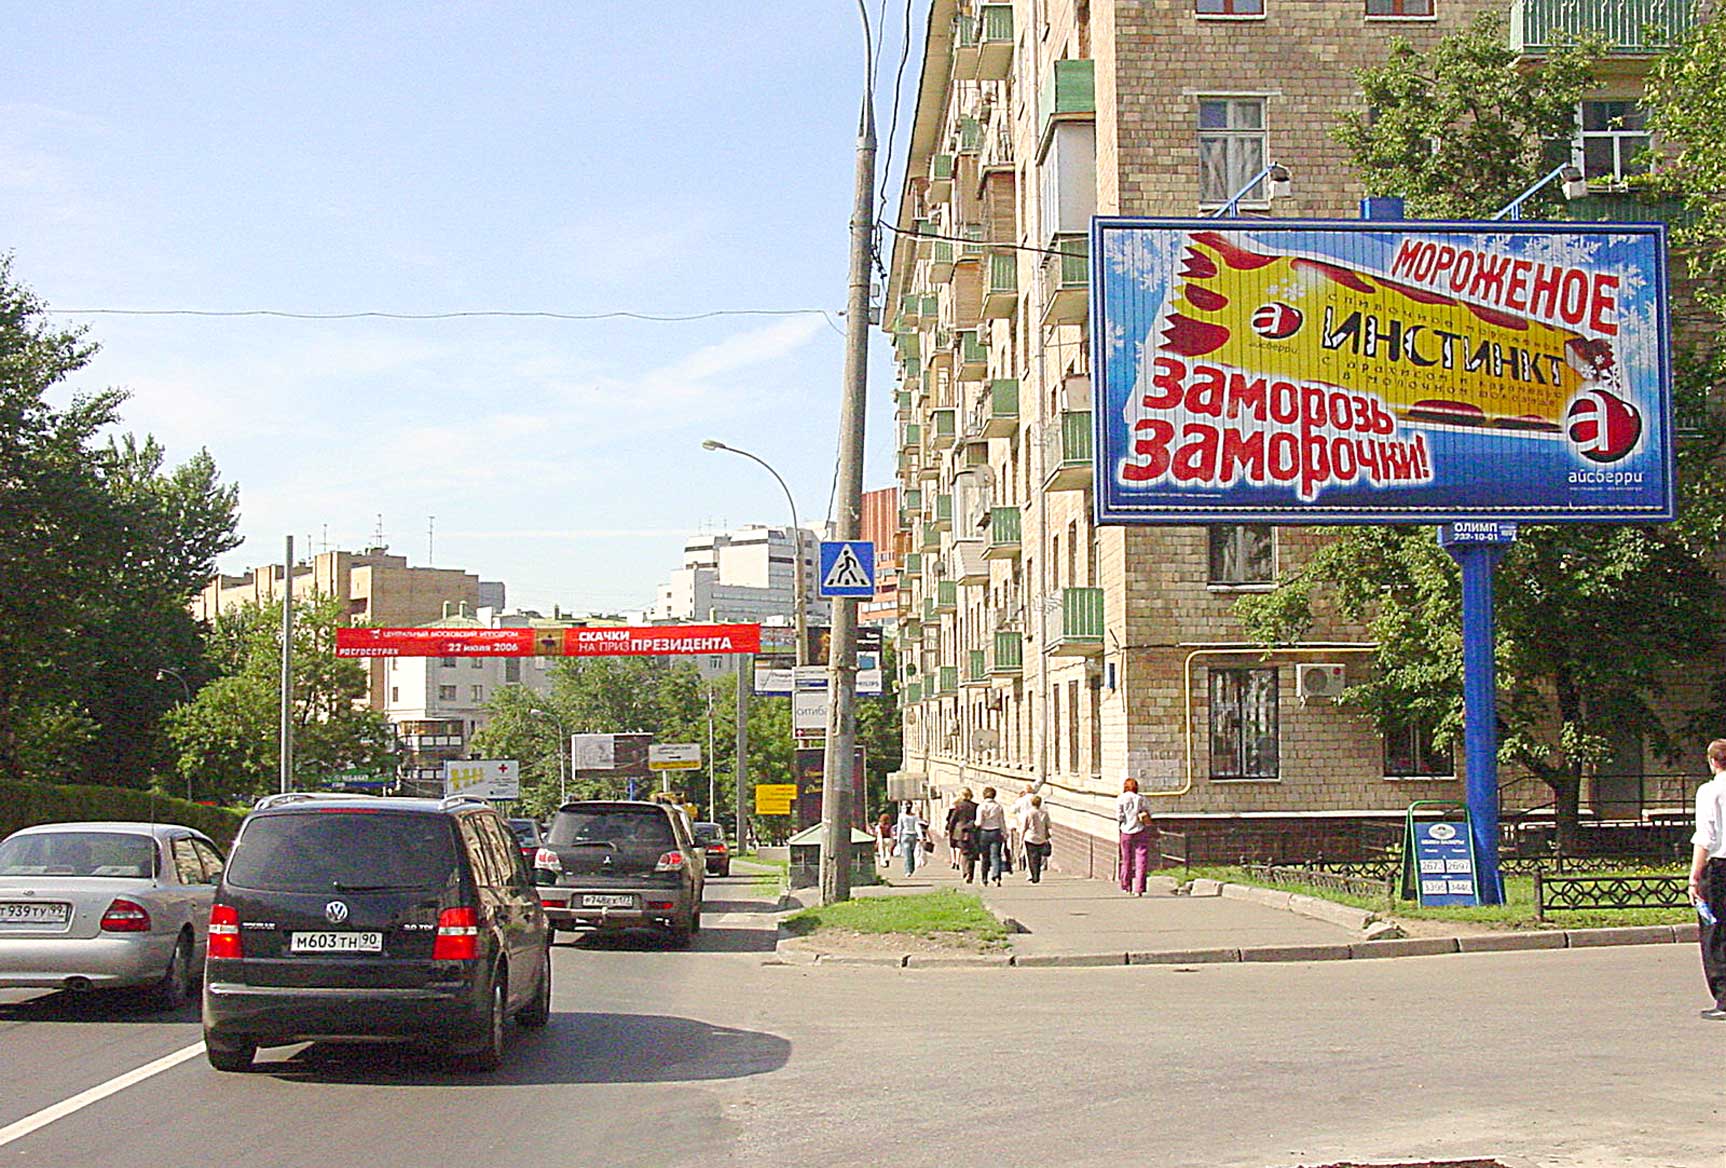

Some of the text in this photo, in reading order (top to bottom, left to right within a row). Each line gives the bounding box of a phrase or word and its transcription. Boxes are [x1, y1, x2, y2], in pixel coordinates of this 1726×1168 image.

[1391, 237, 1621, 337] МОРОЖЕНОЕ
[1321, 305, 1565, 388] ИНСТИНКТ
[1567, 468, 1643, 486] айсберри
[1454, 522, 1498, 532] ОЛИМП
[578, 631, 630, 642] СКАЧКИ
[449, 642, 519, 652] 22 июля 2006
[578, 637, 733, 652] НА ПРИЗ ПРЕЗИДЕНТА
[362, 934, 377, 944] 90
